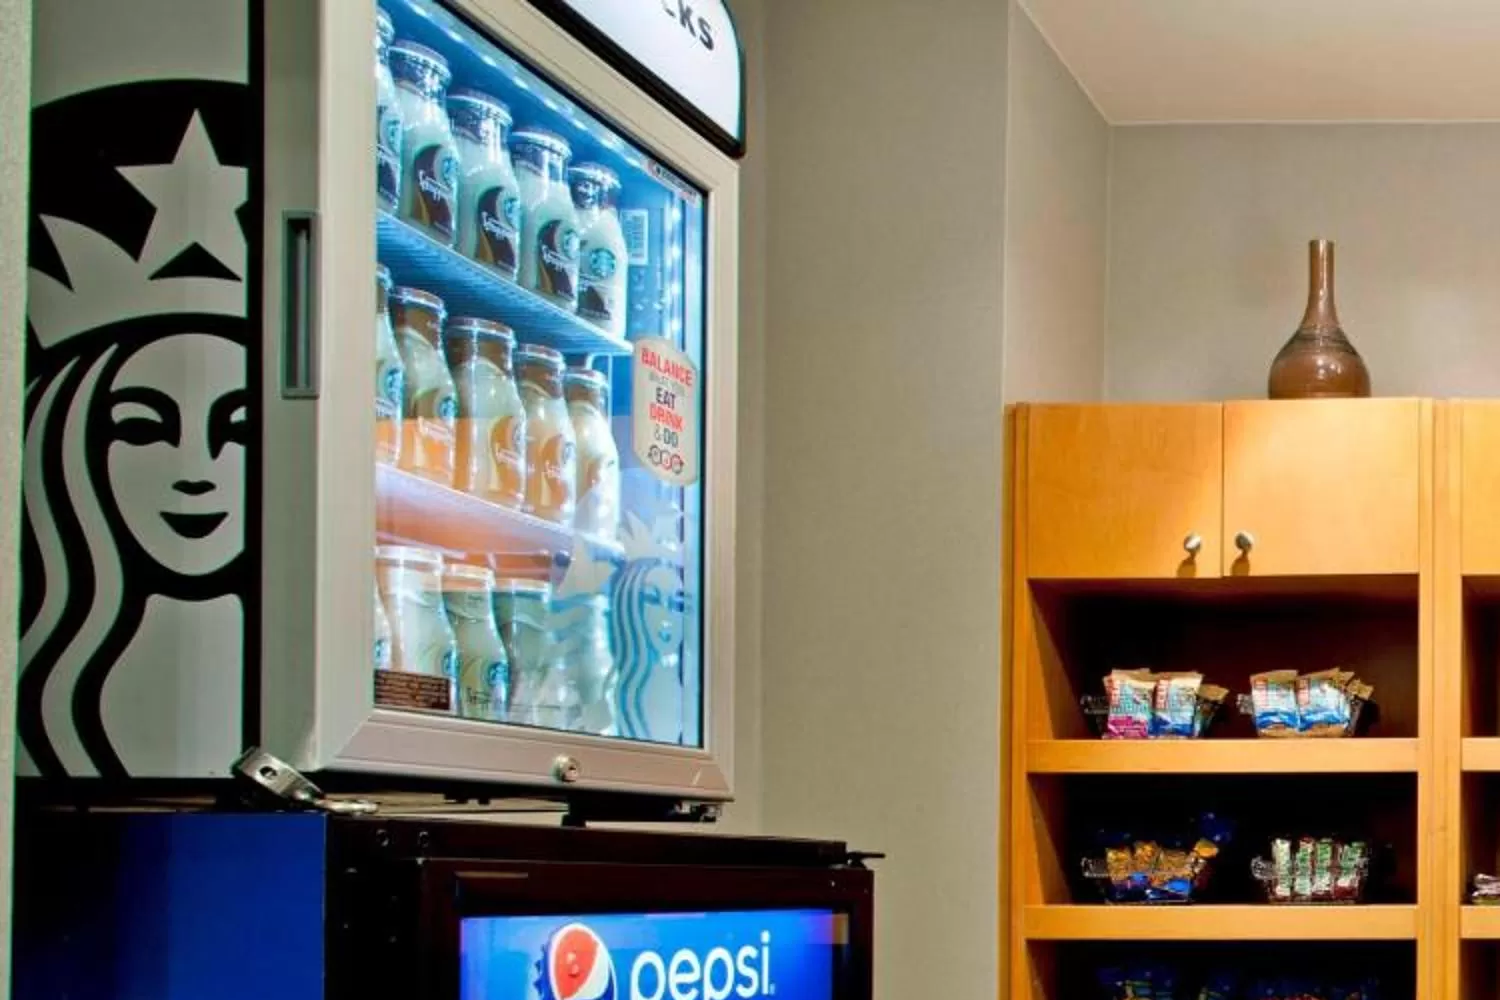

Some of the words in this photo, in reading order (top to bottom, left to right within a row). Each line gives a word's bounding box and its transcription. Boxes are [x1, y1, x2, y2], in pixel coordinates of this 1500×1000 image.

[641, 347, 692, 386] BALANCE
[656, 387, 676, 410] EAT
[649, 404, 684, 431] DRINK
